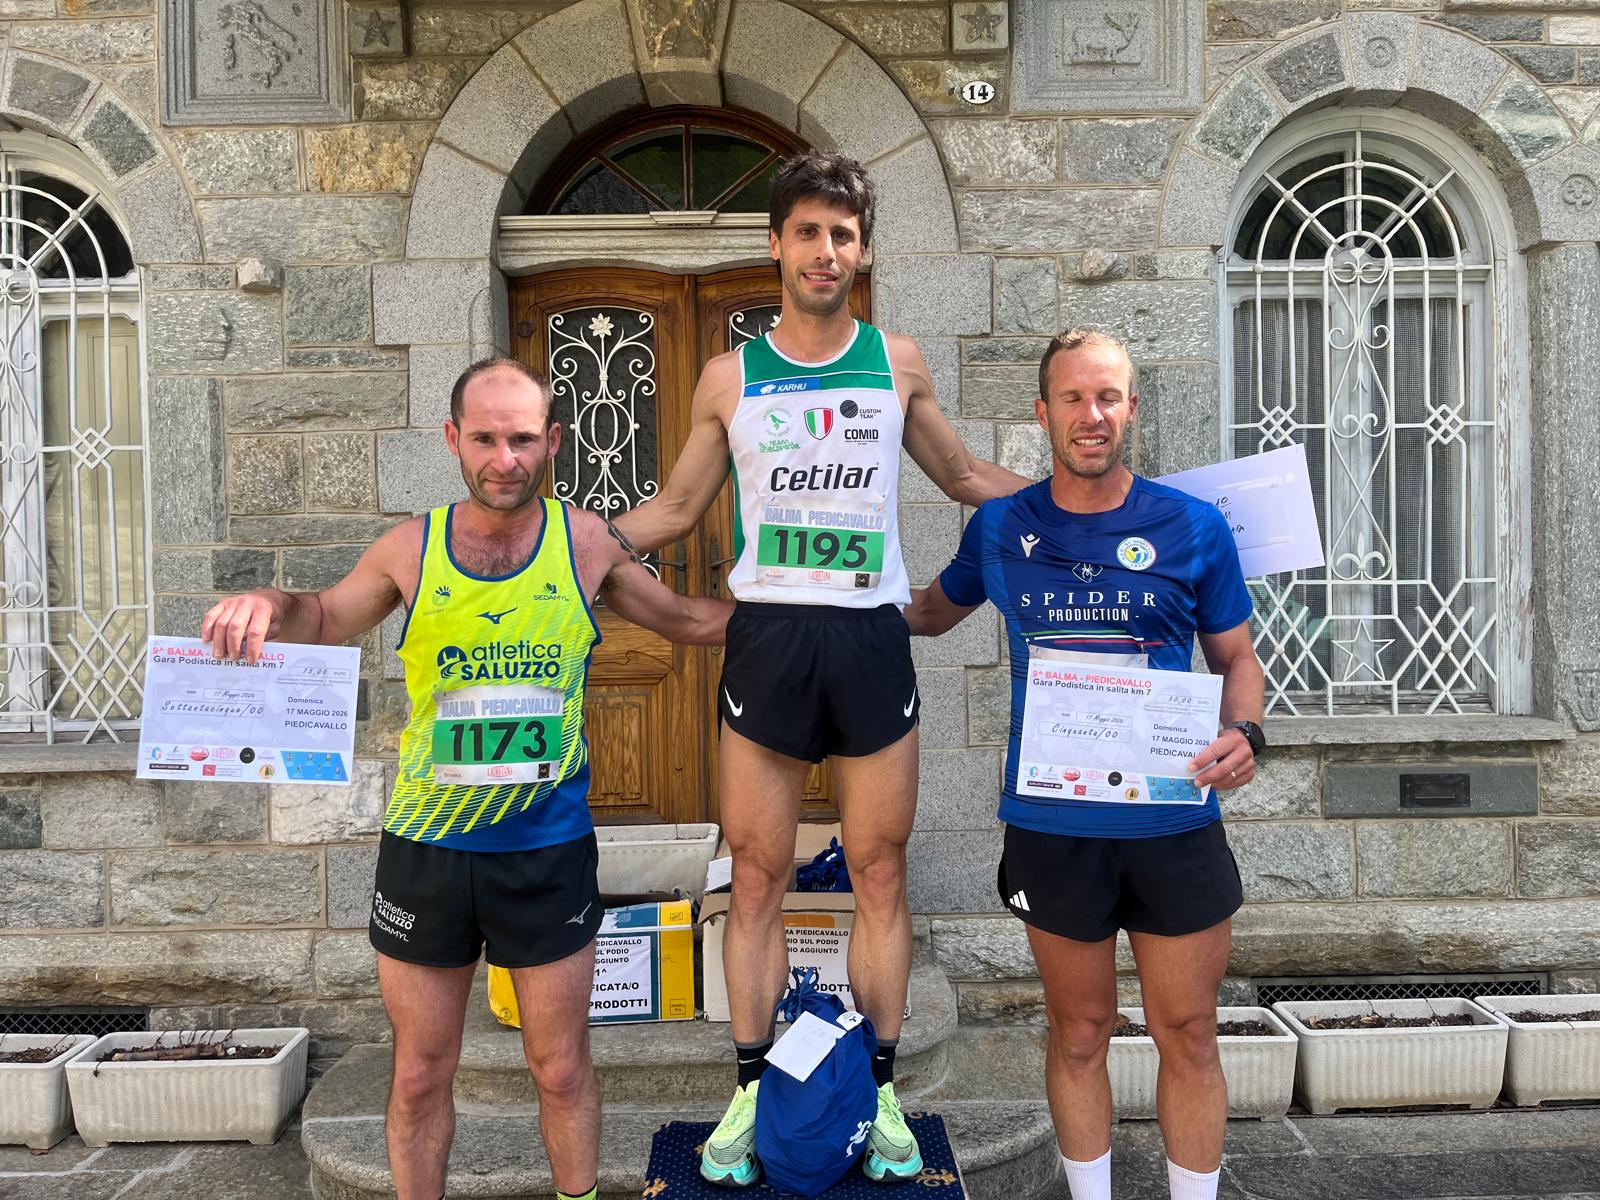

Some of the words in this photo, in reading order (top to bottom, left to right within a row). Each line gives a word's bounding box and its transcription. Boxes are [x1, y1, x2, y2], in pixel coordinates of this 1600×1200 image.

[969, 85, 988, 100] 14
[777, 383, 807, 392] KARHU
[844, 429, 879, 440] COMID
[770, 463, 879, 492] Cetilar
[764, 507, 802, 524] BALMA
[808, 510, 884, 530] PIEDICAVALLO
[774, 529, 867, 568] 1195
[1021, 590, 1156, 607] SPIDER
[1049, 608, 1129, 622] PRODUCTION
[167, 647, 204, 657] BALMA
[471, 640, 562, 661] atletica
[153, 655, 176, 664] Gara
[179, 656, 222, 666] Podistica
[263, 660, 276, 668] km
[279, 661, 284, 669] 7
[461, 660, 561, 681] SALUZZO
[1033, 678, 1053, 687] Gara
[1055, 680, 1094, 691] Podistica
[1096, 684, 1104, 692] in
[1106, 685, 1129, 694] salita
[1131, 686, 1144, 696] km
[1146, 688, 1152, 696] 7
[1045, 671, 1078, 682] BALMA
[1085, 674, 1151, 688] PIEDICAVALLO
[287, 696, 324, 704] Domenica
[441, 700, 476, 717] BALMA
[481, 697, 561, 716] PIEDICAVALLO
[286, 707, 295, 715] 17
[297, 708, 330, 717] MAGGIO
[332, 709, 348, 717] 2026
[284, 720, 347, 730] PIEDICAVALLO
[1051, 723, 1118, 739] Cinquanta/00
[1153, 723, 1188, 733] Domenica
[450, 720, 547, 761] 1173
[1151, 735, 1161, 743] 17
[1162, 736, 1194, 745] MAGGIO
[1195, 738, 1210, 746] 2026
[378, 904, 413, 930] SALUZZO
[383, 900, 415, 922] atletica
[596, 938, 642, 947] EDICAVALLO
